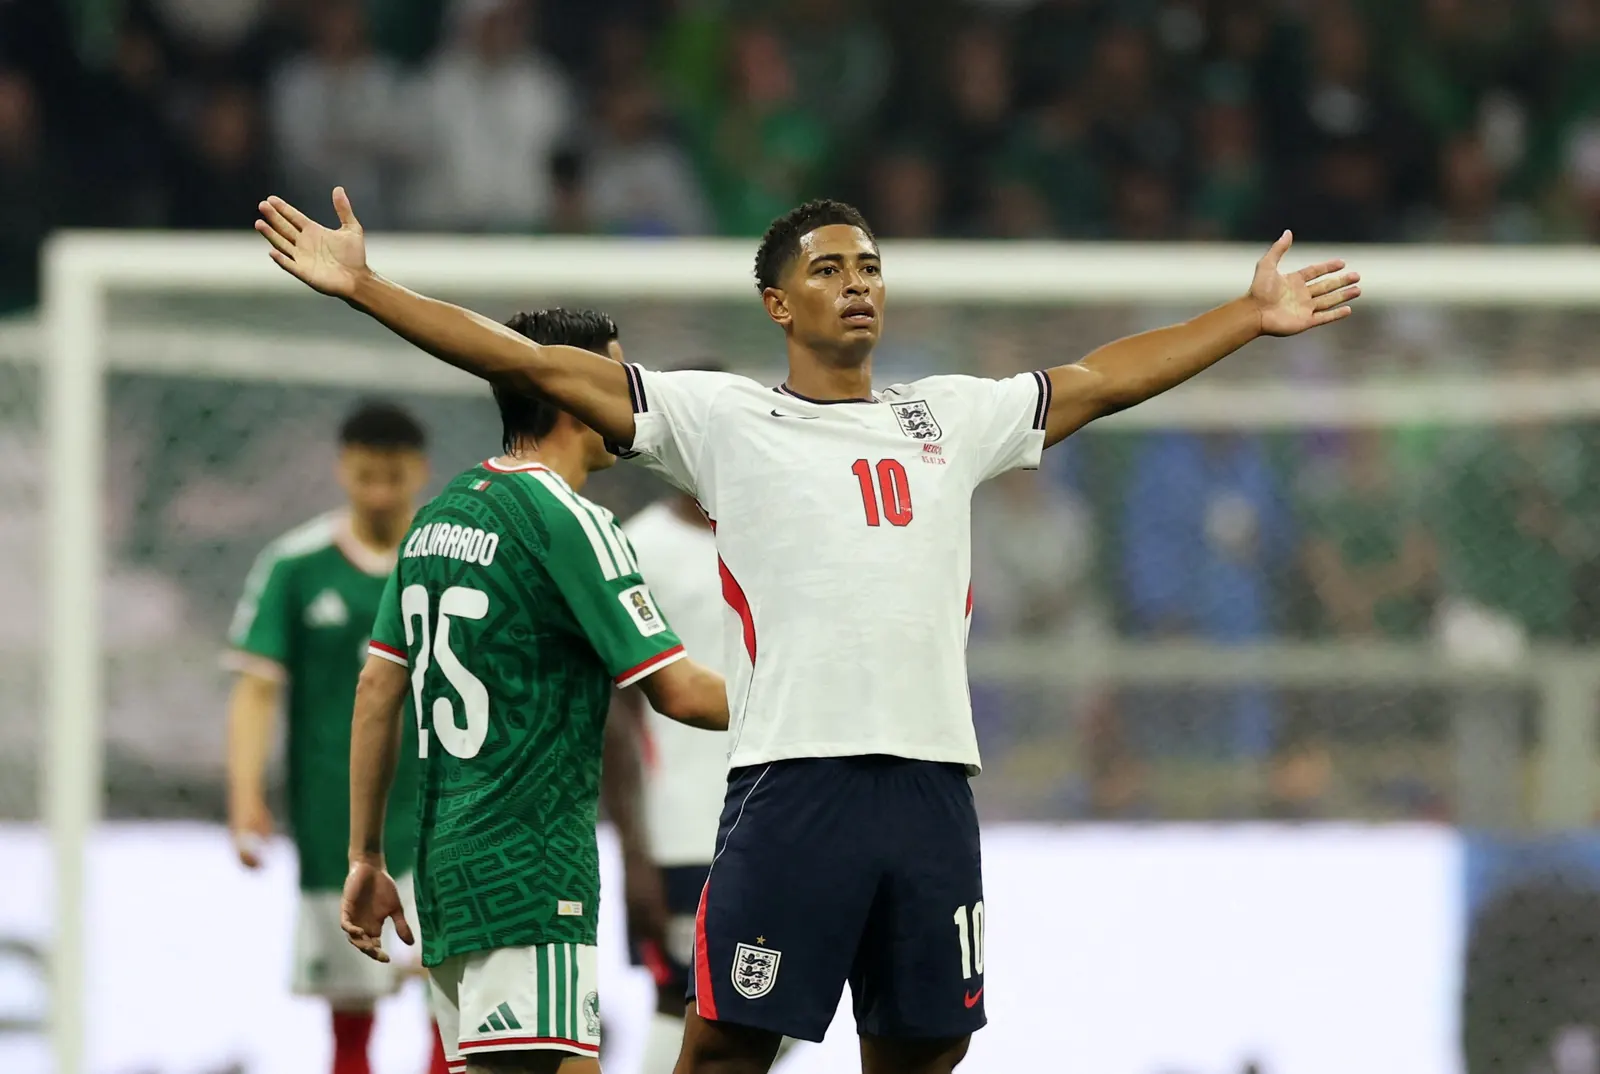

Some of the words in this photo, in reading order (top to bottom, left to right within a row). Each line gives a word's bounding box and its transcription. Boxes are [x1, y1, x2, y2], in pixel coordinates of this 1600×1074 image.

[851, 458, 913, 527] 10
[401, 583, 489, 759] 25
[953, 900, 984, 980] 10
